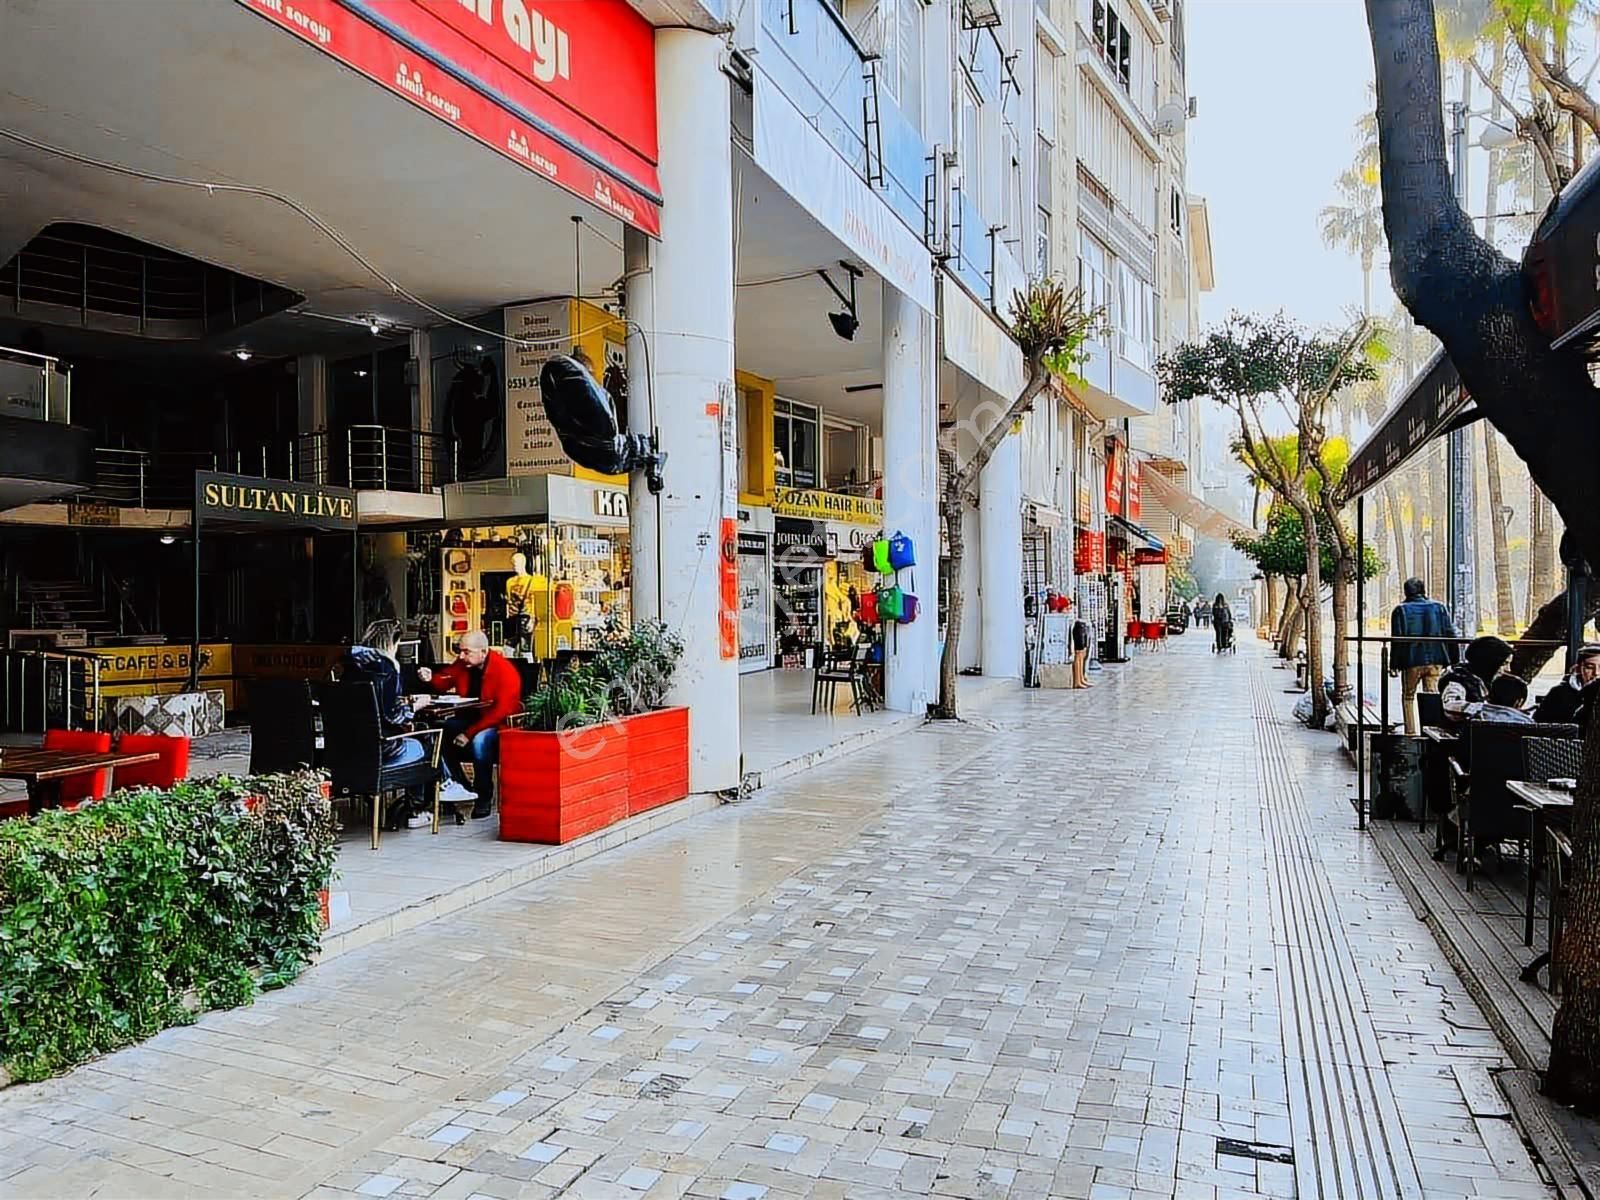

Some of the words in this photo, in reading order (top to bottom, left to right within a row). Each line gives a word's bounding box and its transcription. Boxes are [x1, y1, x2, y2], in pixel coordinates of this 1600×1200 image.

[205, 483, 296, 513] SULTAN
[302, 491, 353, 519] LİVE
[785, 490, 820, 508] OZAN
[824, 496, 852, 512] HAIR
[776, 532, 801, 546] JOHN
[802, 533, 824, 546] LION
[115, 654, 158, 671] CAFE
[162, 653, 174, 668] &
